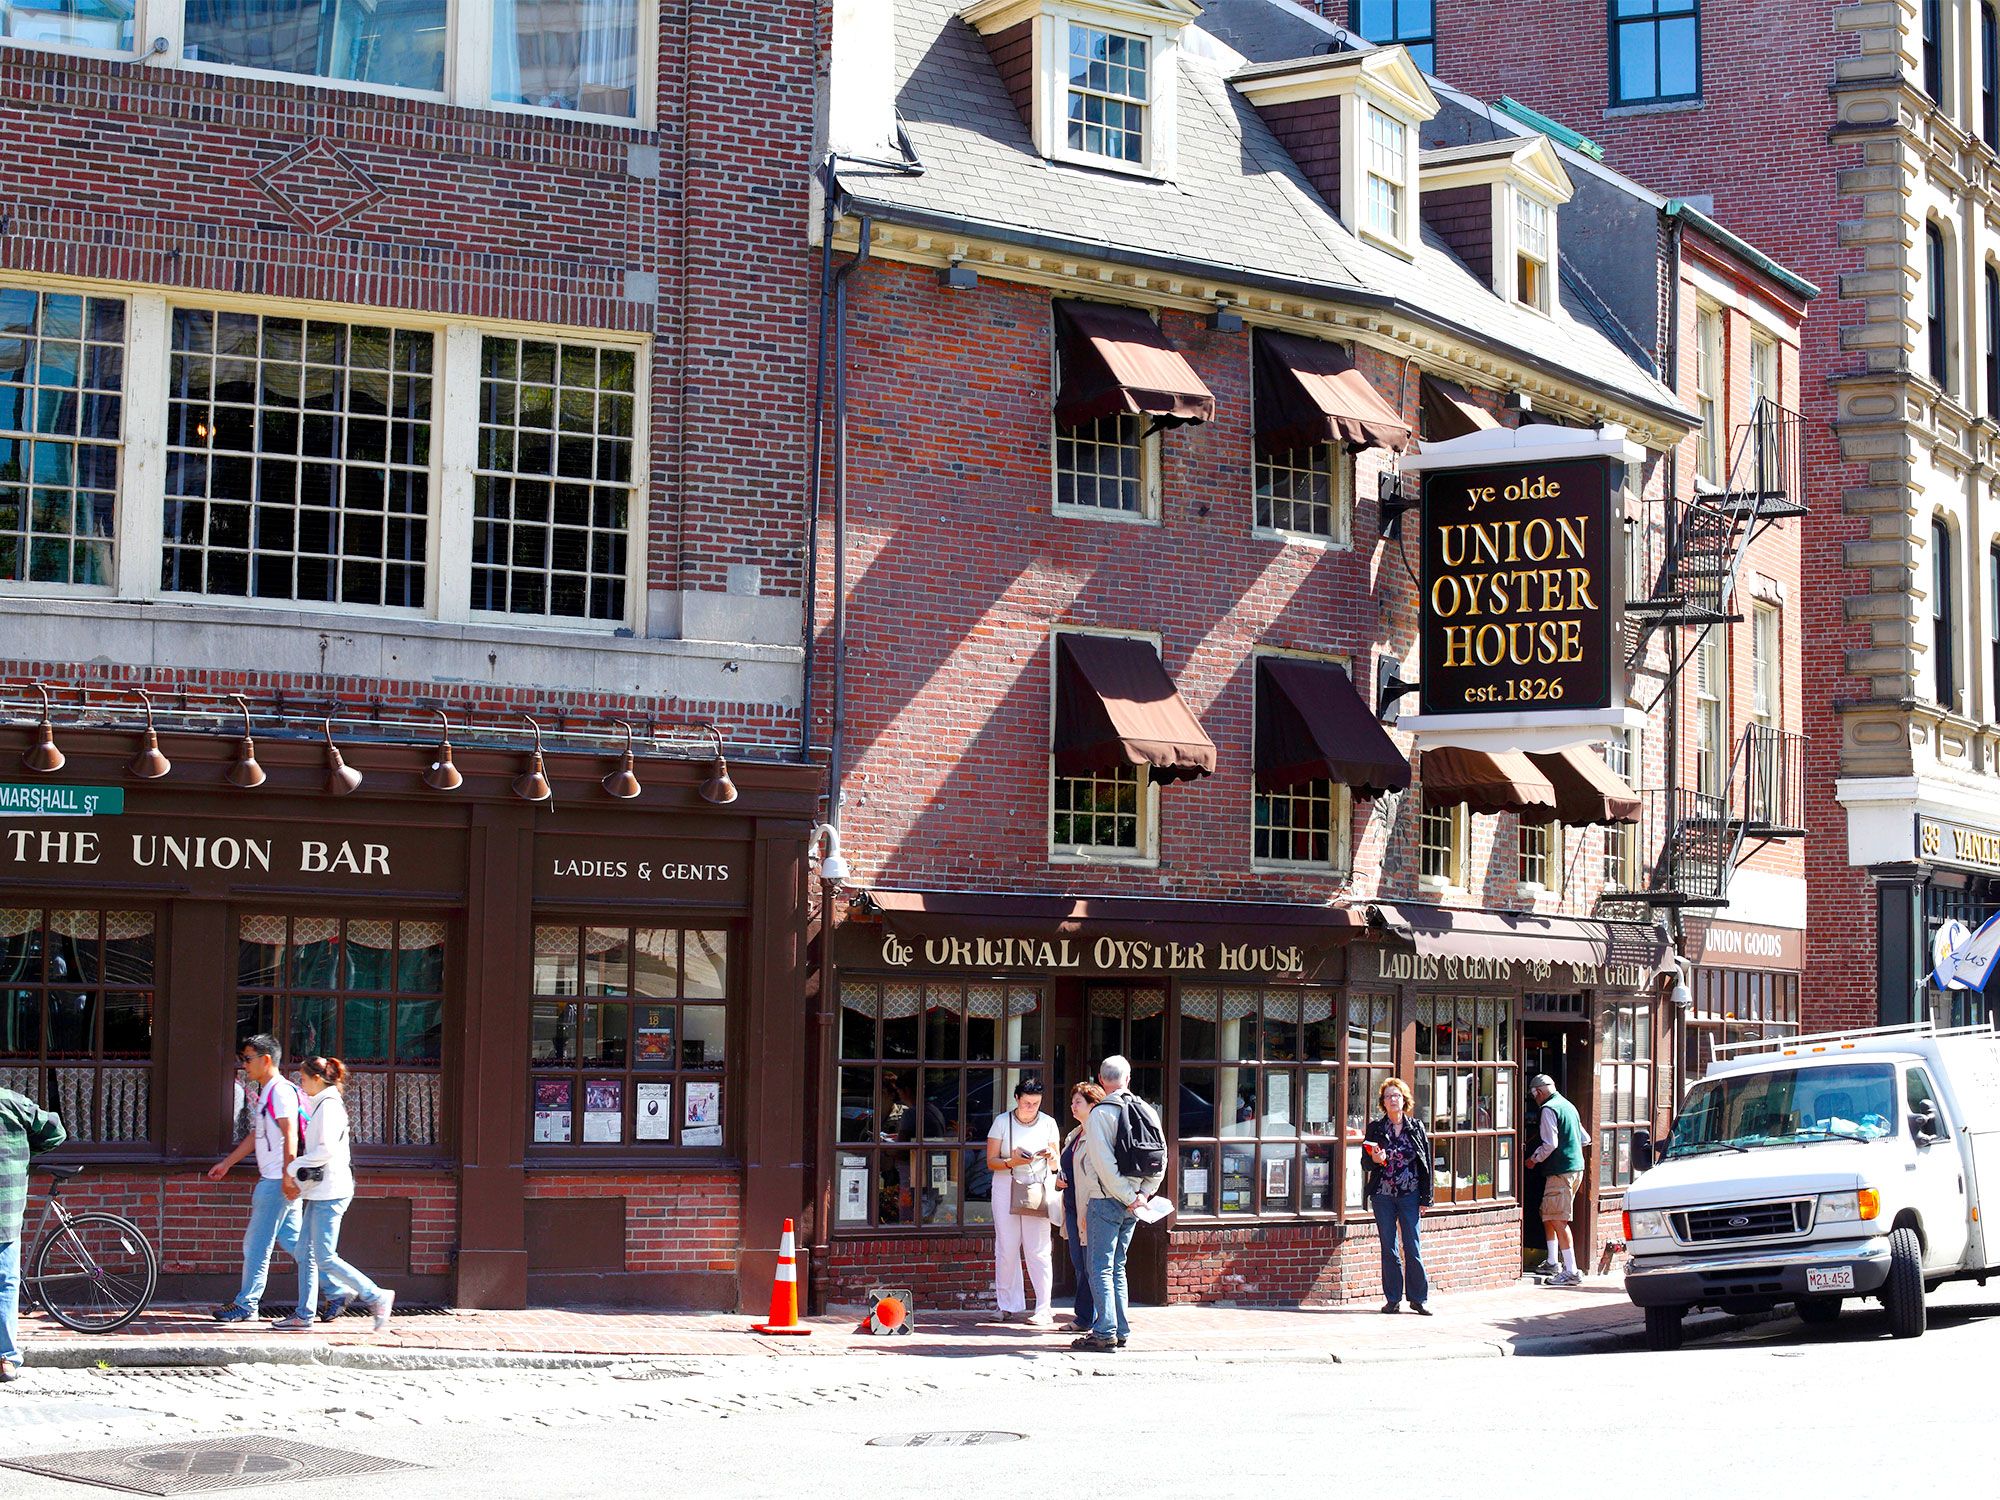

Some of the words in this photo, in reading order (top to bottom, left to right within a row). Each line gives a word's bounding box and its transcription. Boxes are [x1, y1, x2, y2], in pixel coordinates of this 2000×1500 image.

[1467, 486, 1496, 511] ye
[1503, 475, 1561, 501] olde
[1438, 516, 1589, 567] UNION
[1431, 567, 1599, 618] OYSTER
[1442, 619, 1584, 667] HOUSE
[0, 787, 78, 809] MARSHALL
[84, 795, 99, 810] ST
[7, 829, 101, 864] THE
[132, 834, 272, 872] UNION
[300, 840, 391, 875] BAR
[553, 859, 628, 878] LADIES
[637, 862, 652, 881] &
[661, 863, 729, 881] GENTS
[882, 934, 913, 967] The
[925, 936, 1081, 967] ORIGINAL
[1094, 937, 1206, 969] OYSTER
[1218, 941, 1304, 972] HOUSE
[1705, 928, 1742, 953] UNION
[1744, 932, 1781, 957] GOODS
[1379, 949, 1438, 980] LADIES
[1444, 955, 1458, 980] &
[1463, 955, 1510, 980] GENTS
[1572, 961, 1598, 984] SEA
